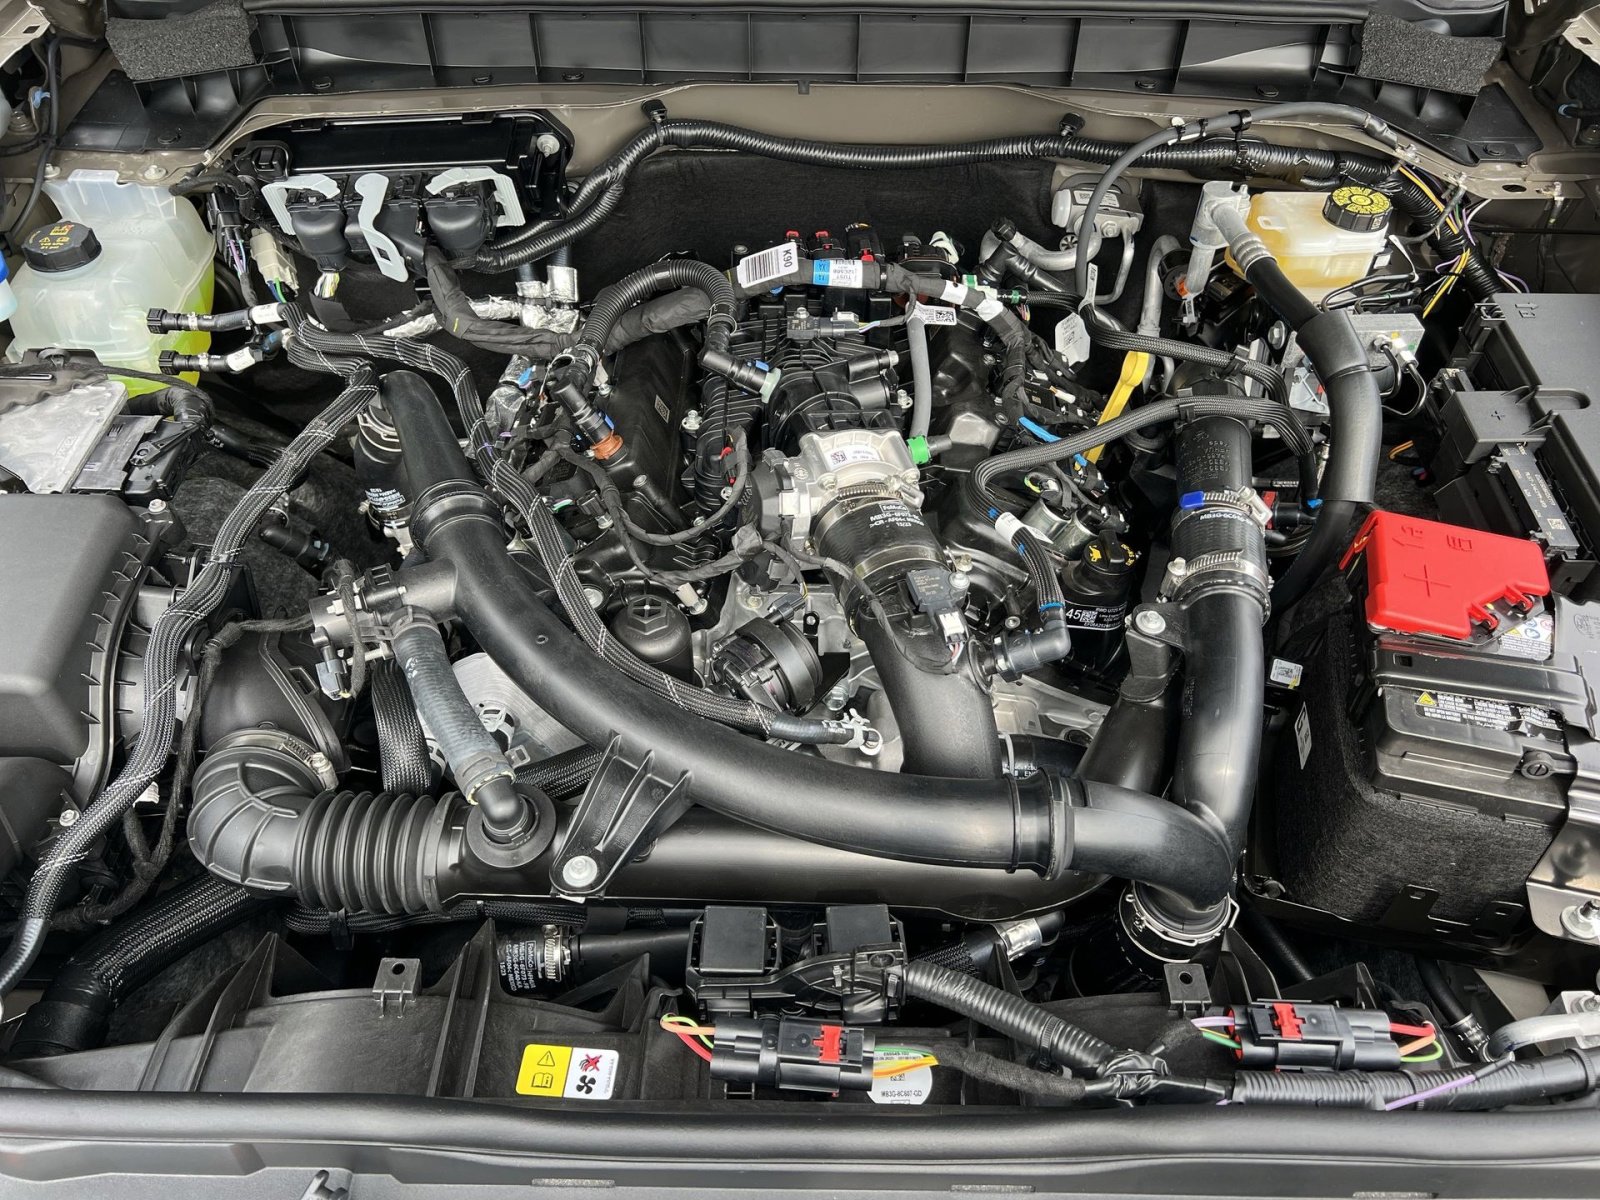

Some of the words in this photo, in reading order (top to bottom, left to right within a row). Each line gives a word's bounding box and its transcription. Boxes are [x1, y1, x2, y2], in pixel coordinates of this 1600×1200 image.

[782, 248, 793, 268] K90
[1065, 608, 1082, 620] 45
[527, 943, 535, 968] FoMoCo
